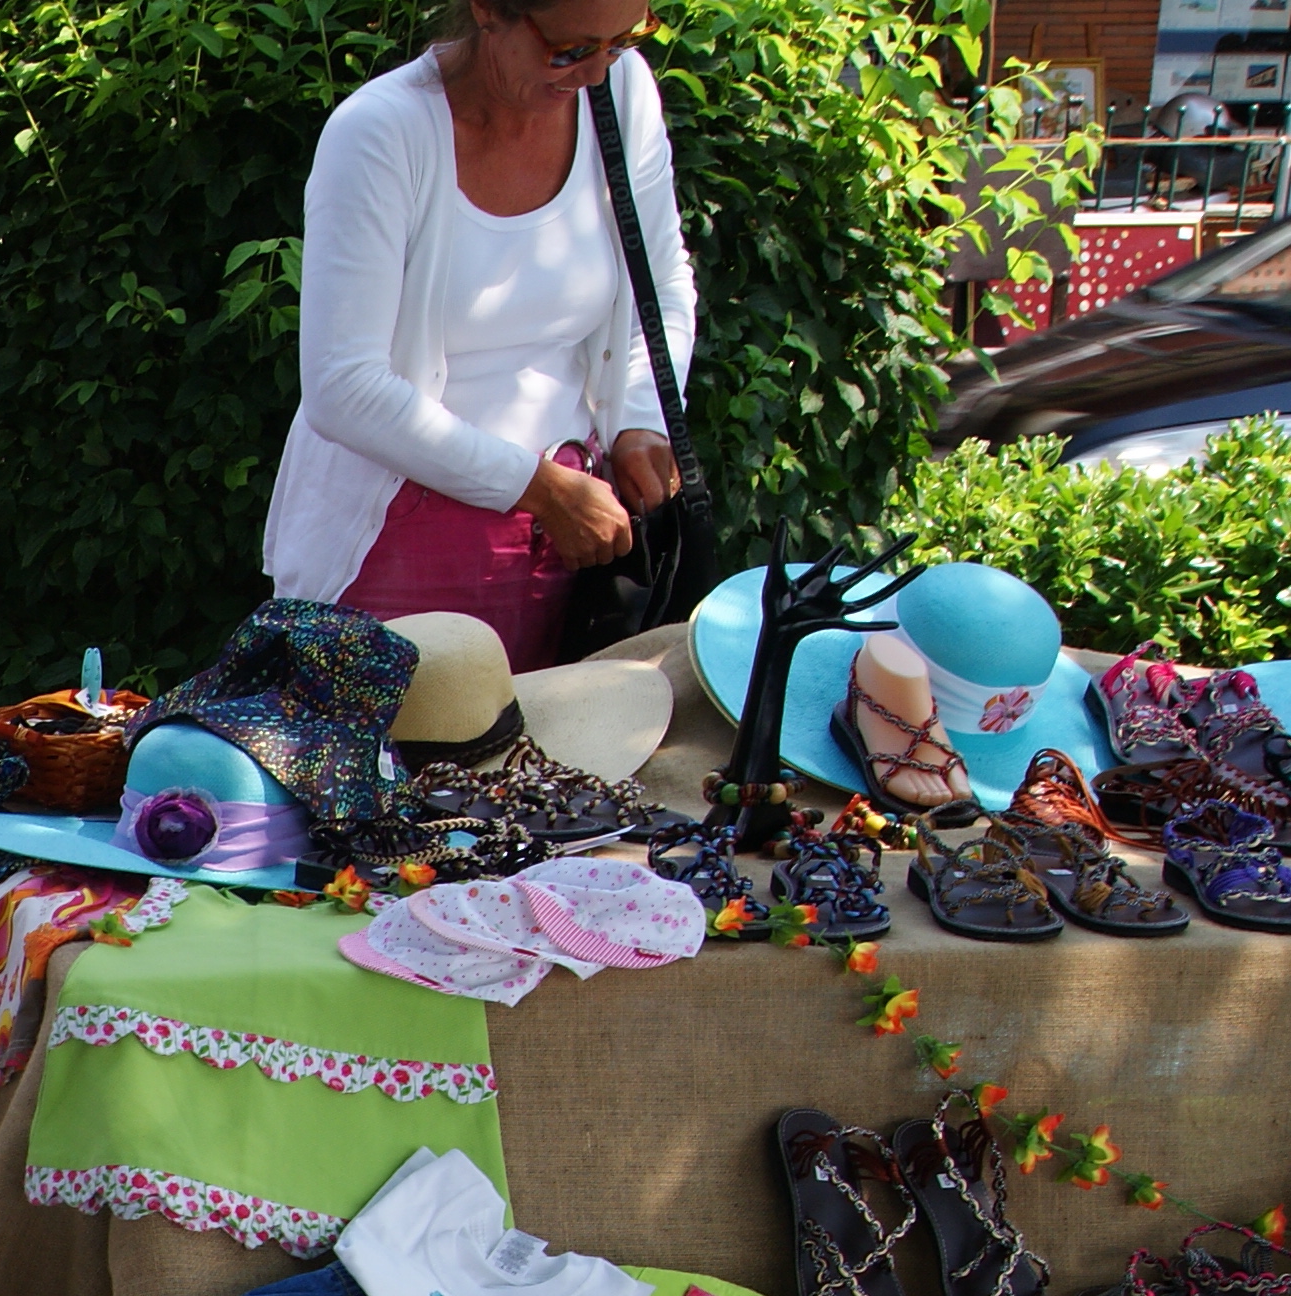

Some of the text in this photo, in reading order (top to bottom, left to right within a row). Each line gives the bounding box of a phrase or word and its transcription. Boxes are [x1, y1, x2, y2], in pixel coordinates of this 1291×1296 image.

[590, 85, 641, 249] OVERI WORLD
[639, 300, 674, 393] COVERI
[668, 400, 701, 486] WORLD
